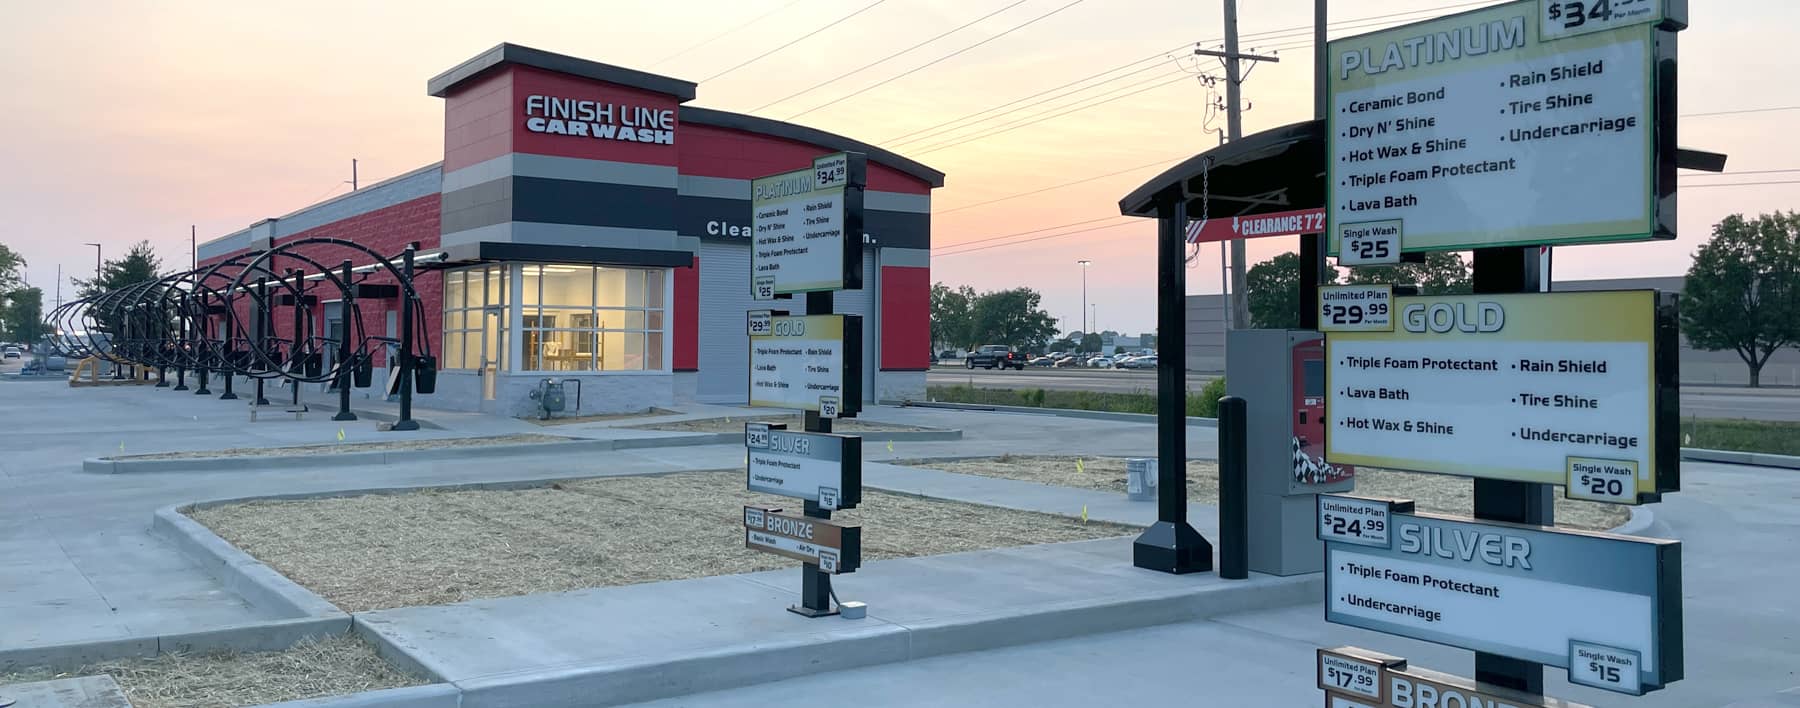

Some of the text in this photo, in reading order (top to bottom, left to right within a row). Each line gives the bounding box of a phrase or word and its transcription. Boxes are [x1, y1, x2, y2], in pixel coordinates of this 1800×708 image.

[1548, 0, 1646, 28] $34.
[1340, 15, 1526, 80] PLATINUM
[1509, 60, 1604, 88] Rain Shield
[1349, 87, 1445, 114] Ceramic Bond
[1509, 92, 1594, 116] Tire Shine
[527, 95, 674, 129] FINISH LINE
[1349, 116, 1436, 140] Dry N' Shine
[1509, 115, 1637, 143] Undercarriage
[1349, 137, 1467, 163] Hot Wax & Shine
[1349, 157, 1516, 188] Triple Foam Protectant
[756, 175, 812, 202] PLATINUM
[1349, 194, 1417, 212] Lava Bath
[706, 221, 752, 237] Clea
[1242, 215, 1302, 235] CLEARANCE
[1344, 226, 1398, 238] Single Wash
[1351, 240, 1389, 258] $25
[1323, 290, 1388, 301] Unlimited Plan
[1323, 303, 1388, 324] $29.99
[1402, 302, 1505, 333] GOLD
[775, 320, 805, 336] GOLD
[1347, 357, 1498, 371] Triple Foam Protectant
[1520, 360, 1606, 373] Rain Shield
[1347, 387, 1409, 401] Lava Bath
[1520, 394, 1598, 409] Tire Shine
[1347, 418, 1454, 435] Hot Wax & Shine
[771, 435, 810, 455] SILVER
[1520, 428, 1638, 449] Undercarriage
[1573, 464, 1631, 475] Single Wash
[1581, 475, 1622, 495] $20
[1323, 502, 1384, 517] Unlimited Plan
[767, 516, 813, 539] BRONZE
[1324, 513, 1384, 536] $24.99
[1400, 523, 1532, 570] SILVER
[1348, 563, 1499, 598] Triple Foam Protectant
[1348, 594, 1441, 622] Undercarriage
[1324, 656, 1377, 676] Unlimited Plan
[1578, 649, 1632, 666] Single Wash
[1328, 667, 1373, 687] $17.99
[1590, 662, 1620, 683] $15
